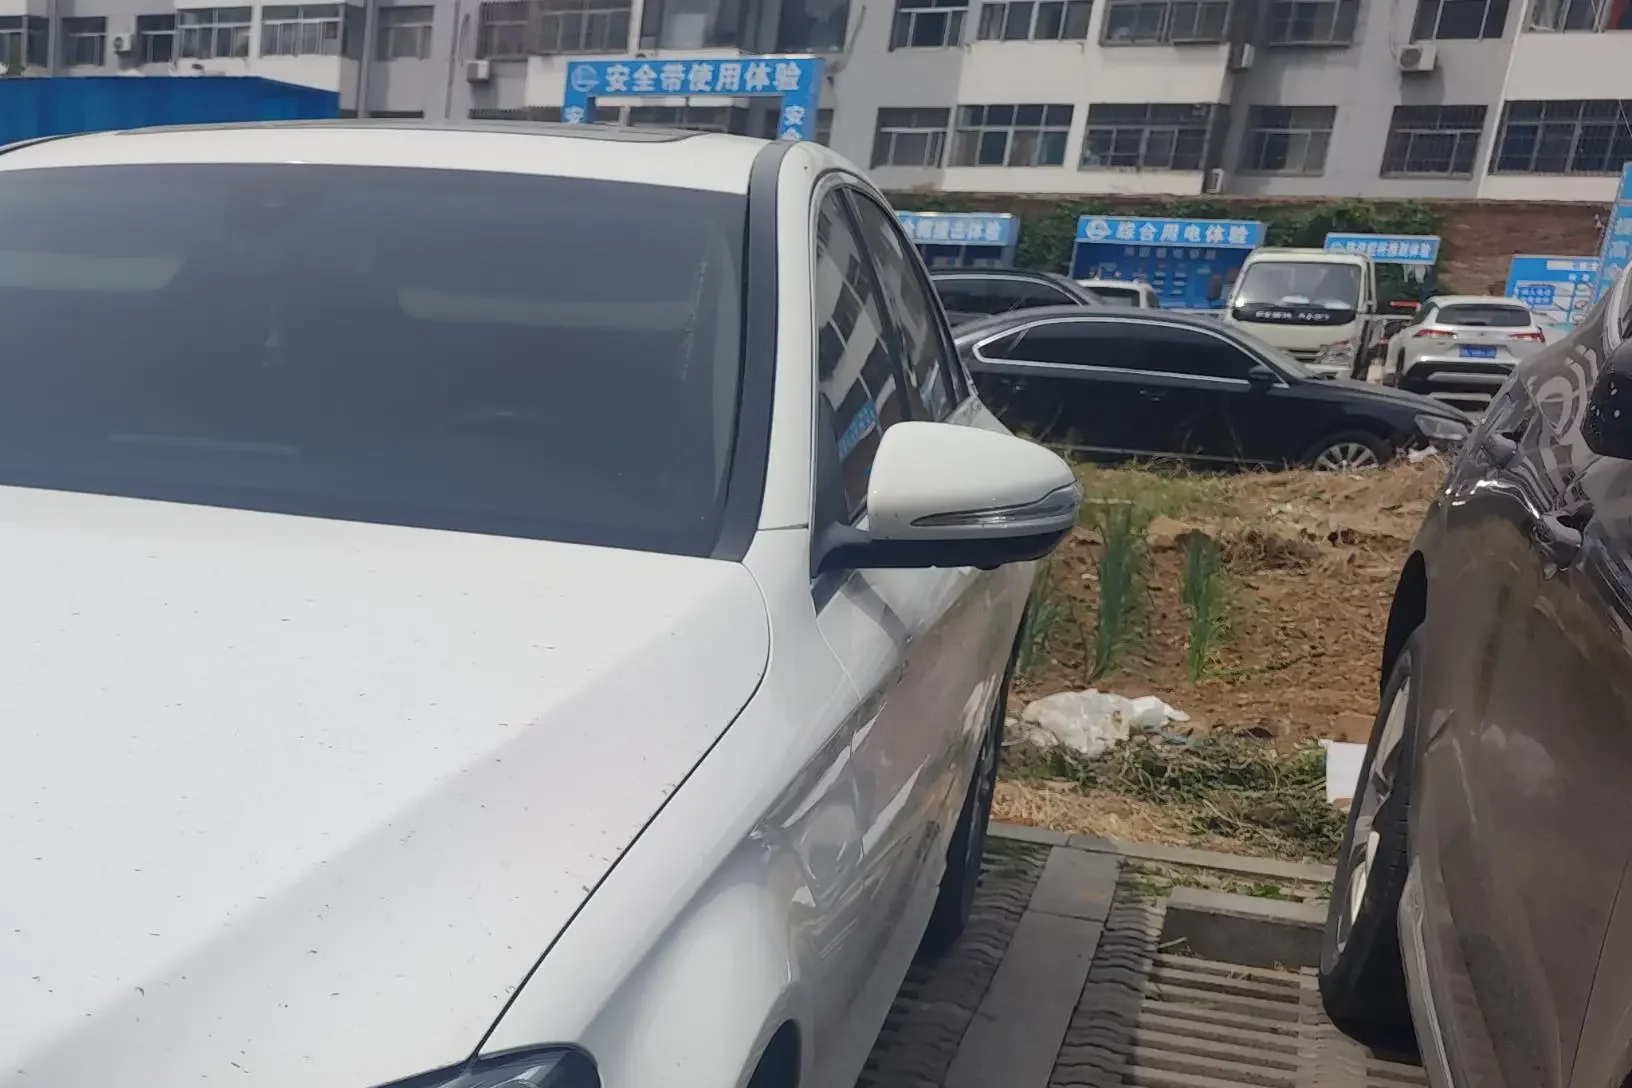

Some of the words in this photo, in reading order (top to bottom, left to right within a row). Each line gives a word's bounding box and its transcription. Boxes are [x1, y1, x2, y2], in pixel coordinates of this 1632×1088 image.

[605, 63, 802, 92] 安全带使用体验
[1116, 221, 1249, 244] 综合用电体验
